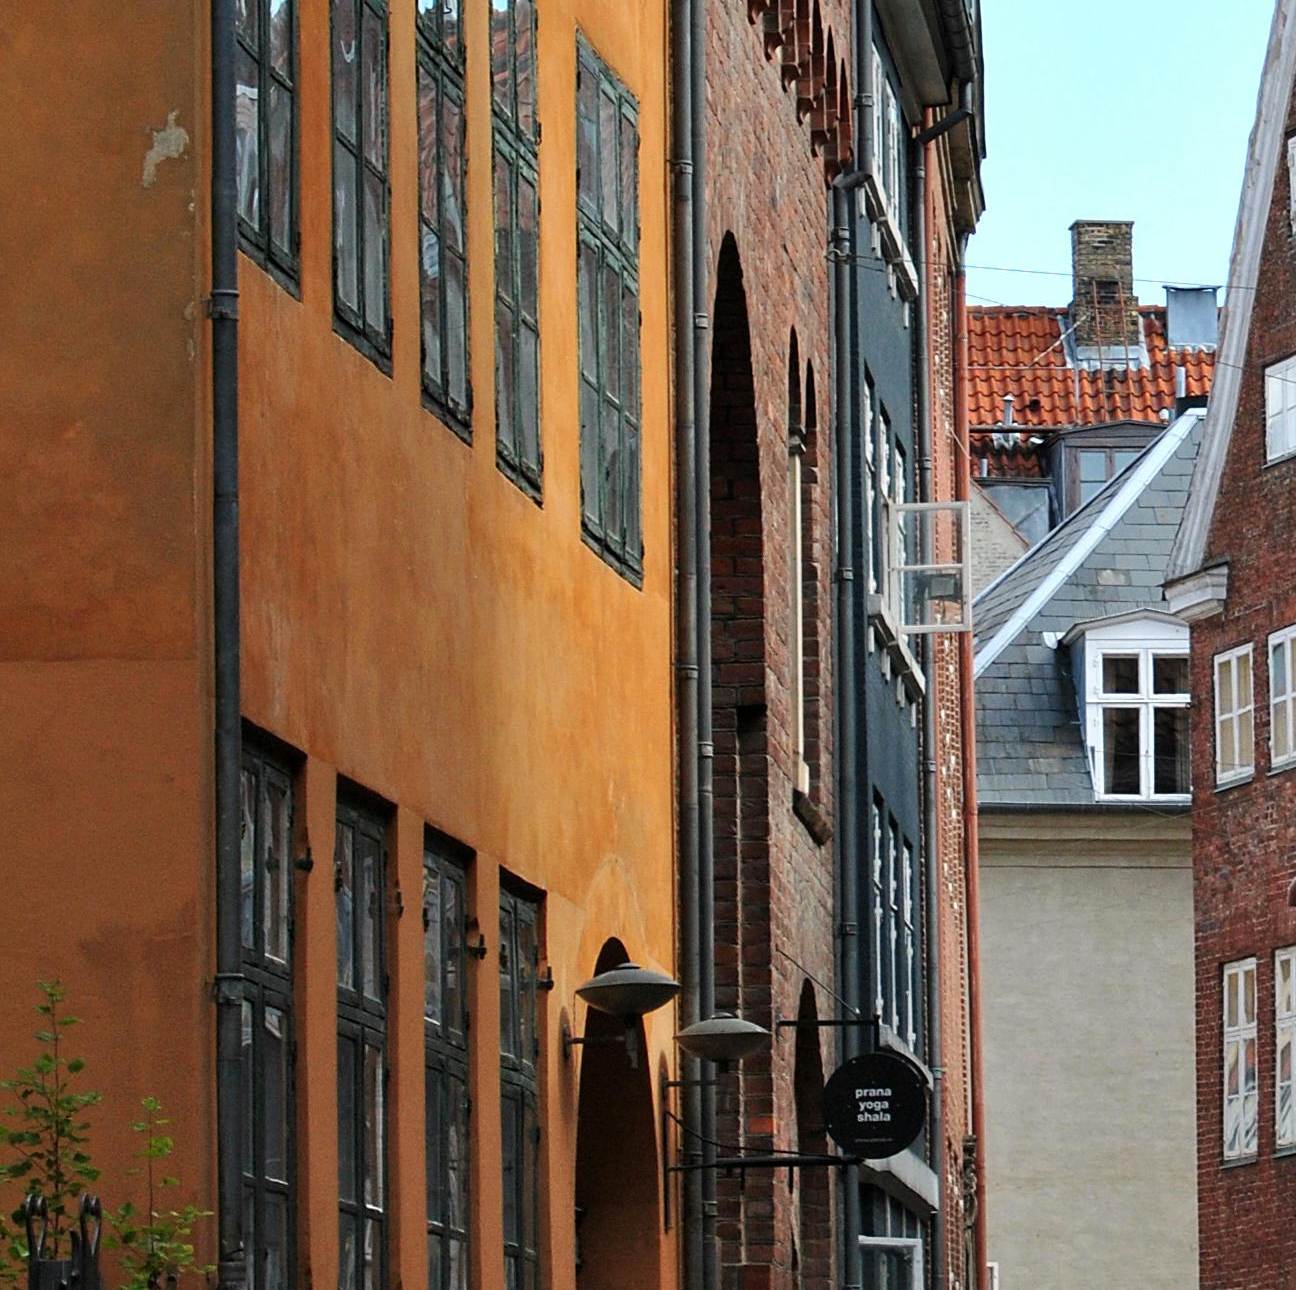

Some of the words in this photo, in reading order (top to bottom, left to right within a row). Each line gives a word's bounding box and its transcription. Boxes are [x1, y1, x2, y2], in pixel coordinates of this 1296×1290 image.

[855, 1088, 892, 1098] prana
[858, 1100, 889, 1111] yoga
[857, 1111, 891, 1121] shala
